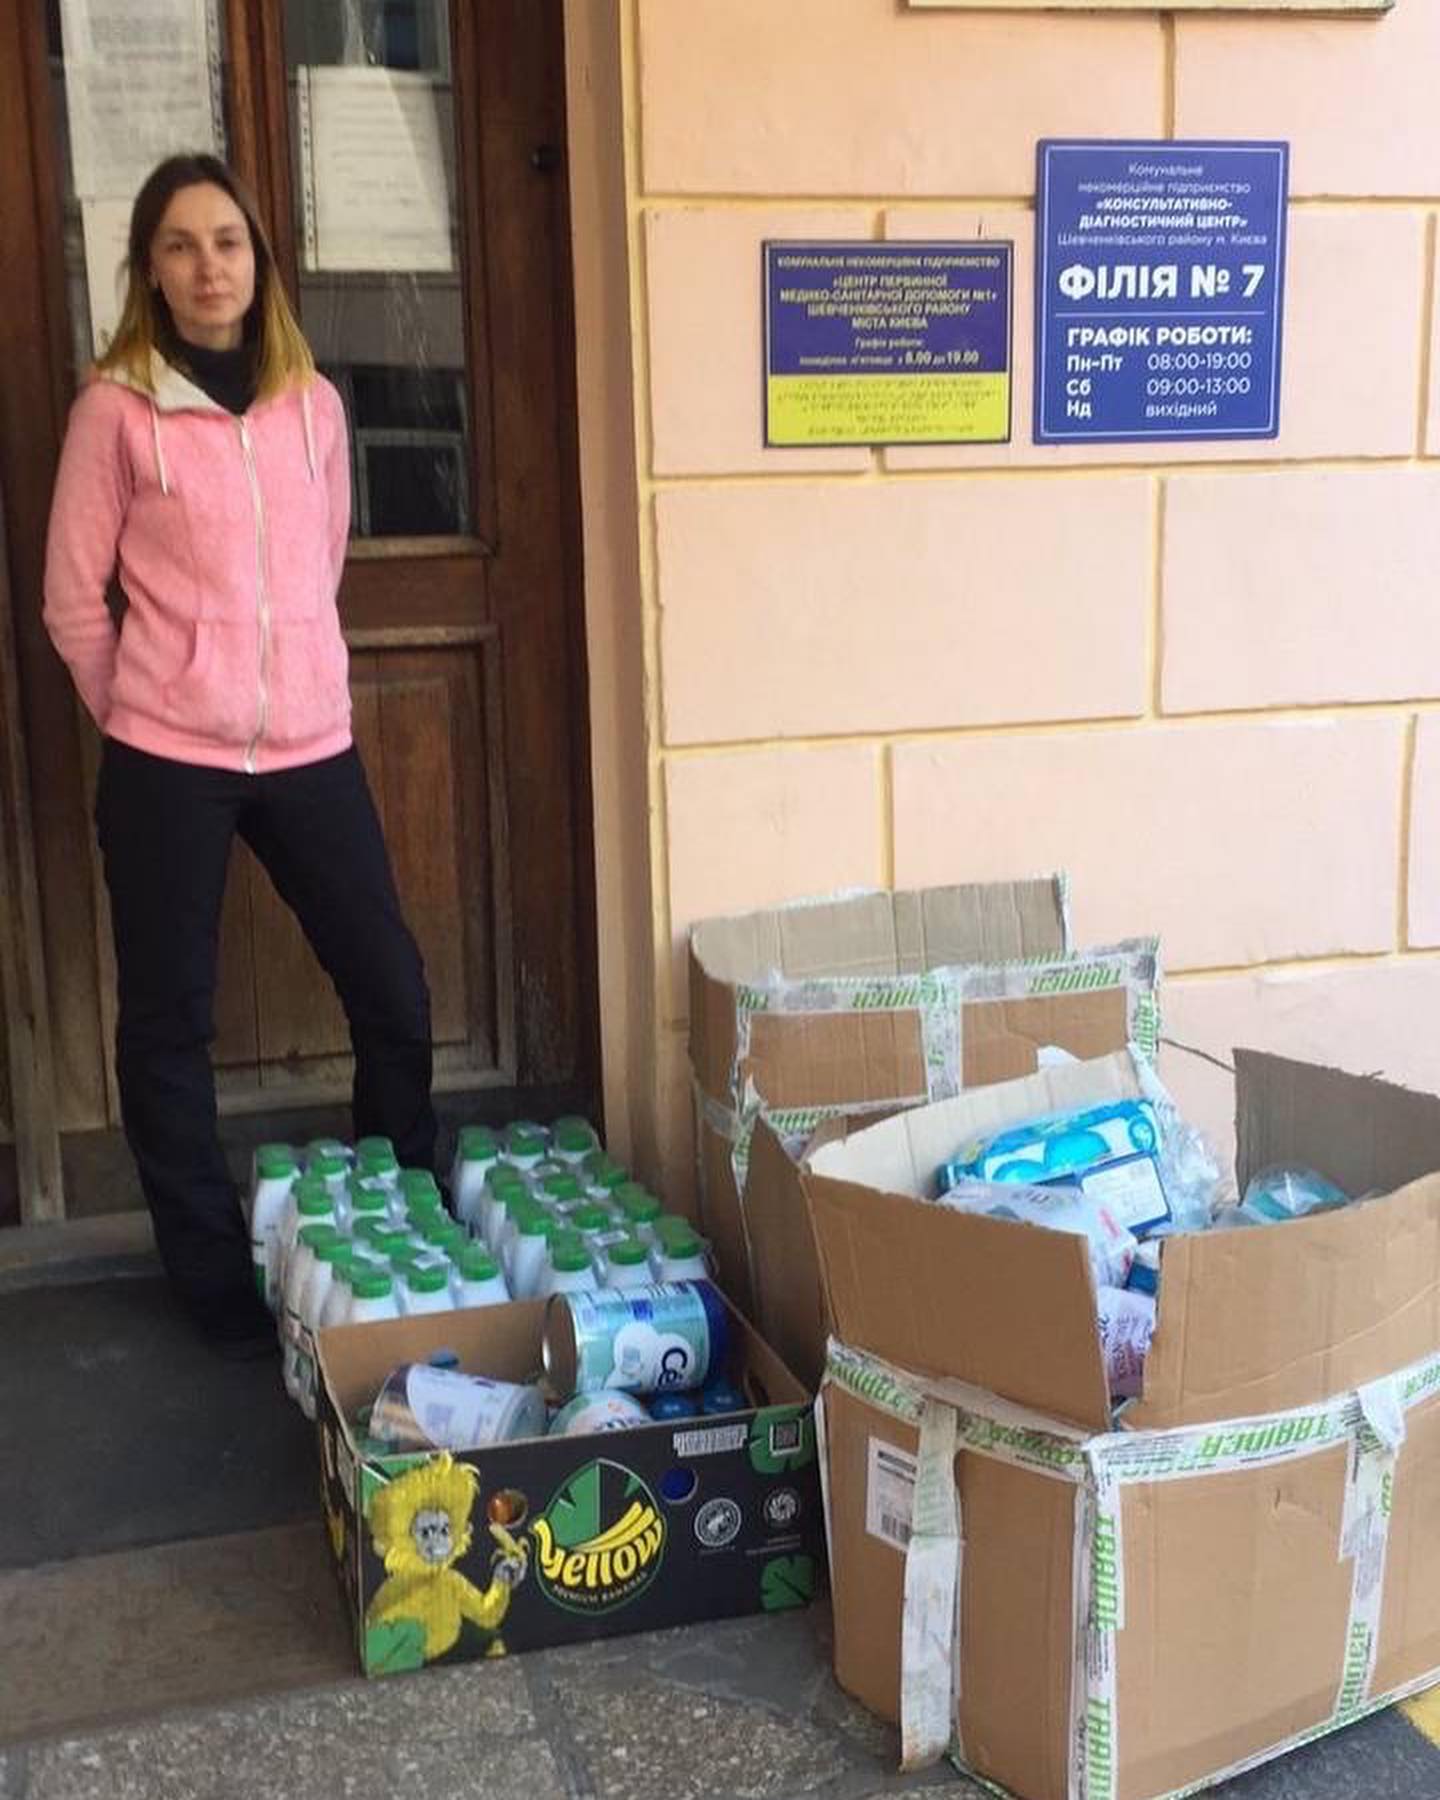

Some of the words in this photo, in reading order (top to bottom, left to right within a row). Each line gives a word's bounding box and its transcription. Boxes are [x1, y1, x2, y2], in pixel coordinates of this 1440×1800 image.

[1079, 214, 1196, 229] ДІАГНОСТИЧНИЙ
[1058, 264, 1179, 301] ФІЛІЯ
[1190, 265, 1231, 298] №
[1242, 264, 1266, 297] 7
[1066, 327, 1150, 348] ГРАФІК
[1156, 326, 1253, 346] РОБОТИ:
[1146, 351, 1252, 371] 08:00-19:00
[1066, 379, 1092, 396] Сб
[1146, 376, 1251, 396] 09:00-13:00
[1066, 402, 1093, 418] Нд
[1145, 400, 1218, 418] вихідний
